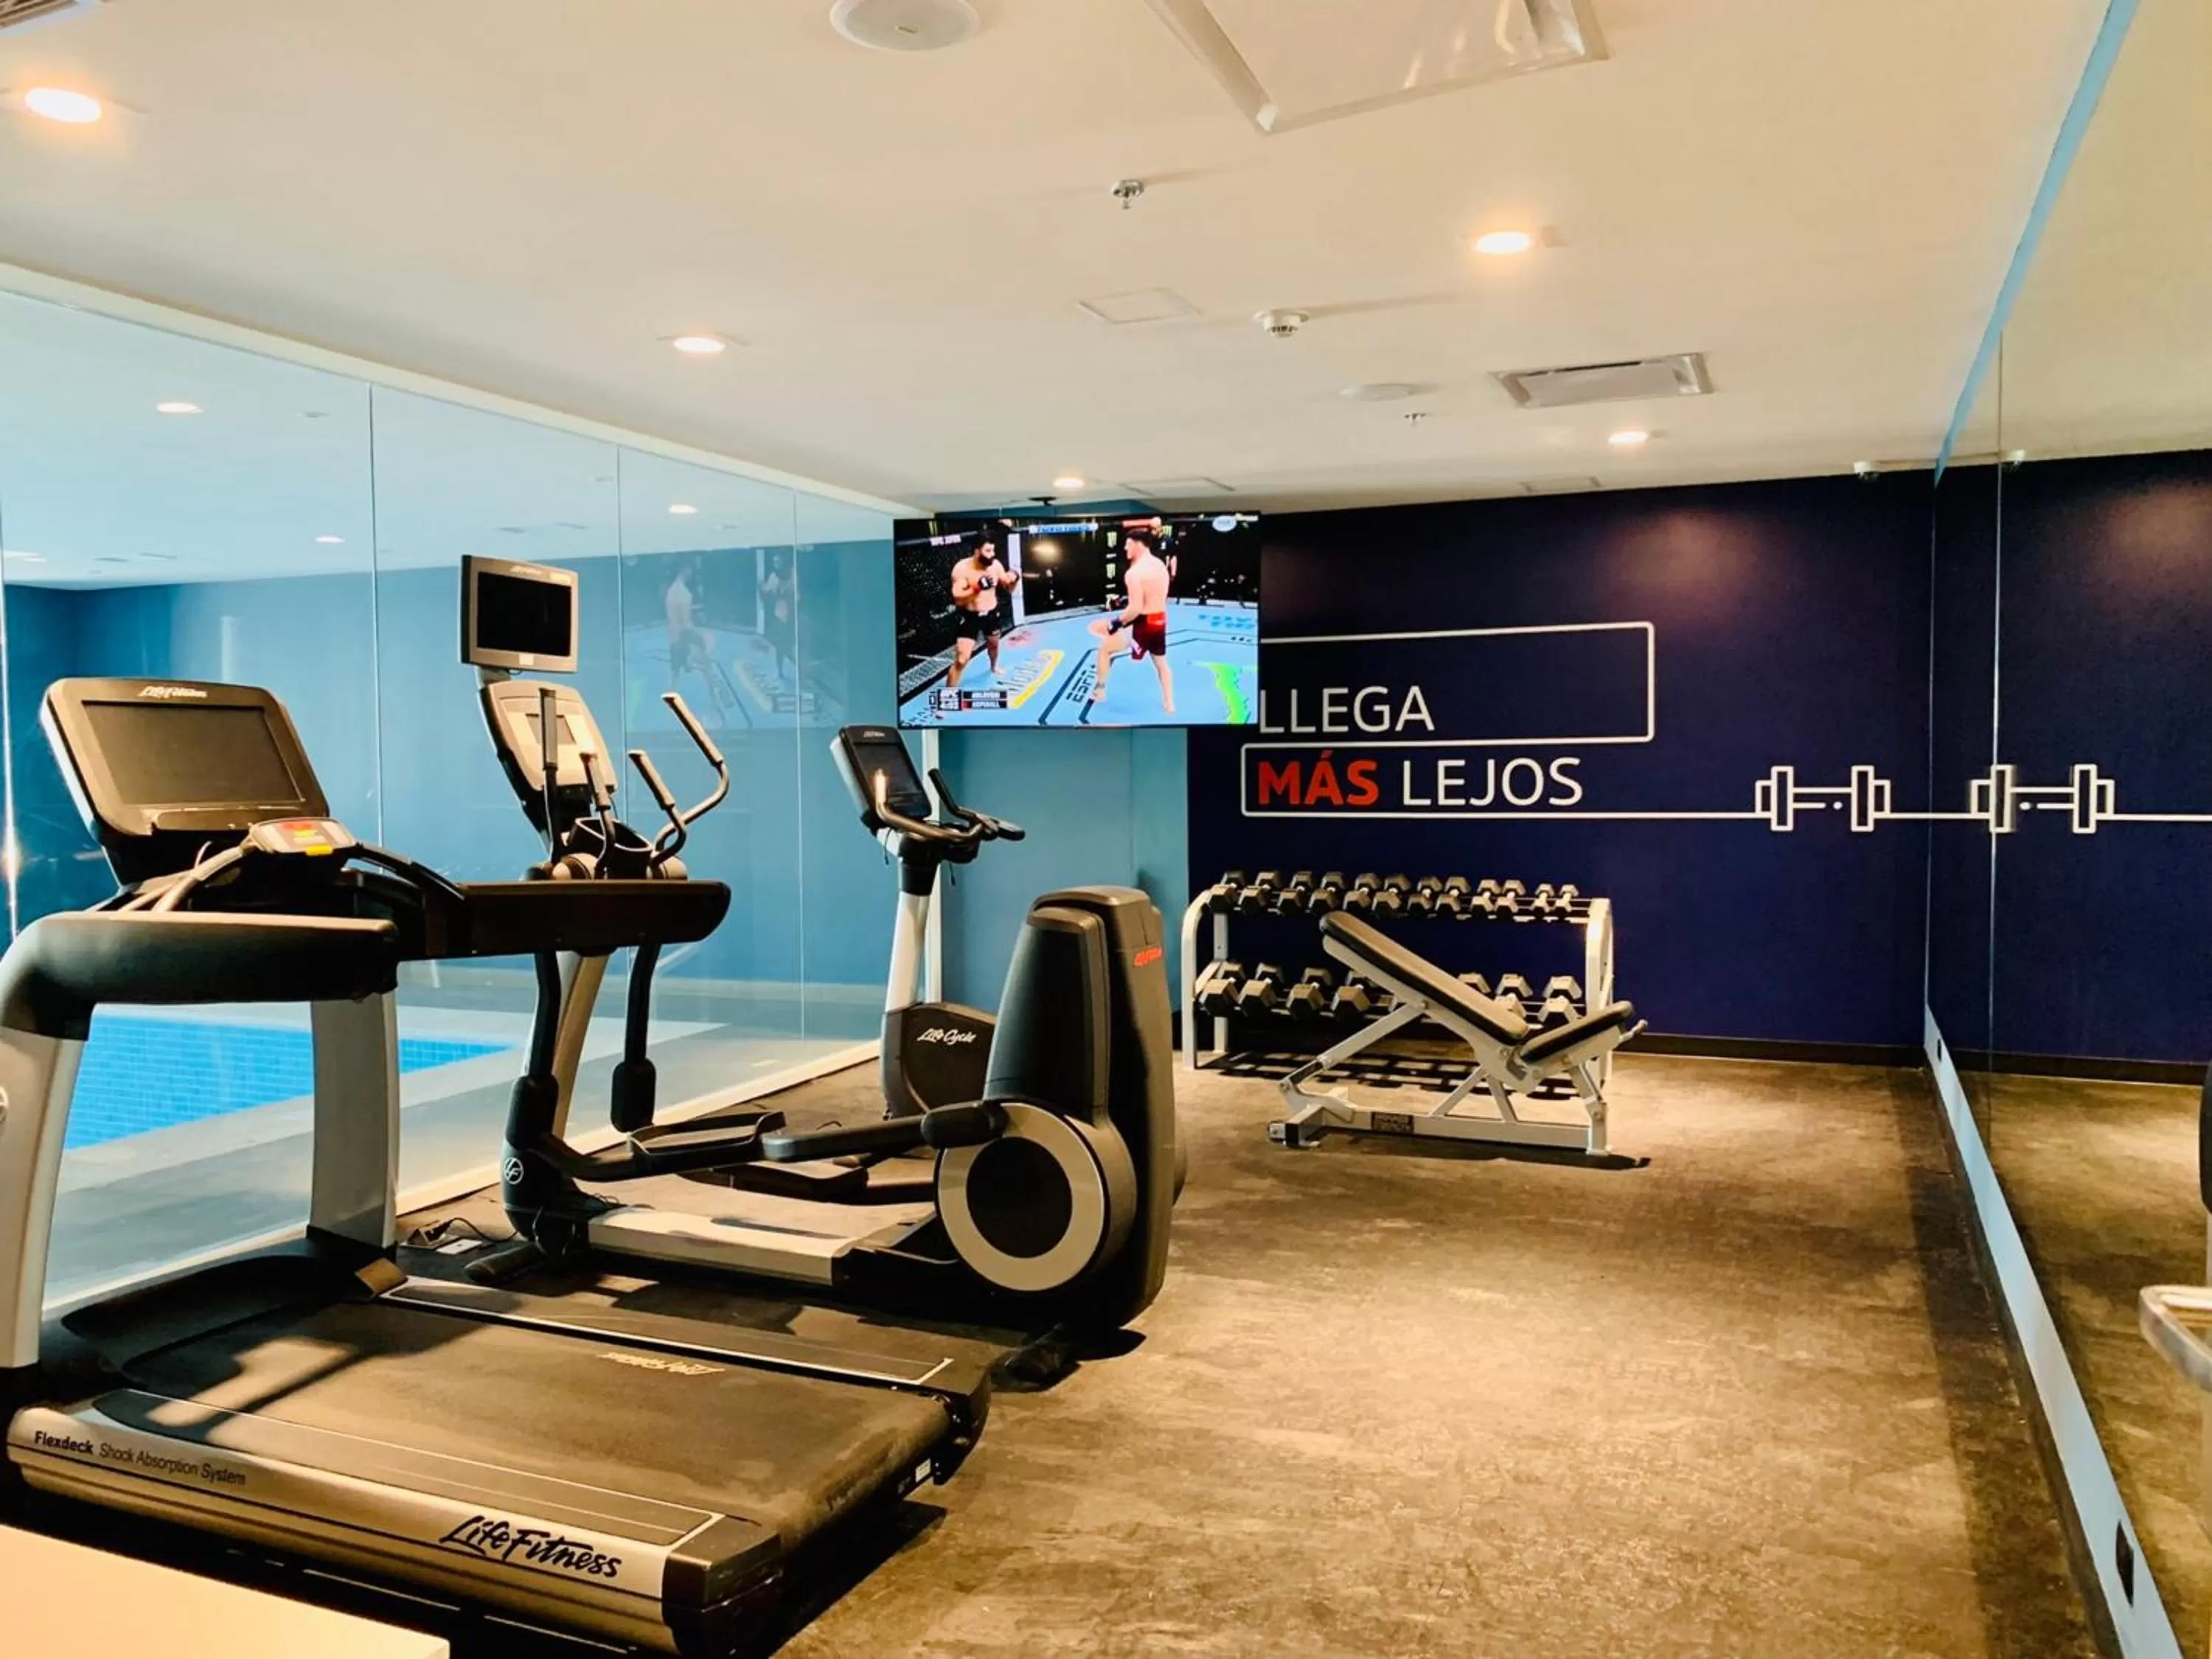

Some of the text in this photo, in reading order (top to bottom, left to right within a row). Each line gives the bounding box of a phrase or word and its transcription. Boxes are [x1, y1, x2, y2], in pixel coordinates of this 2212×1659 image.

[1259, 685, 1435, 734] LLEGA
[1259, 750, 1583, 807] MÁS LEJOS
[34, 1430, 246, 1486] Flexdeck Shock Absorption System
